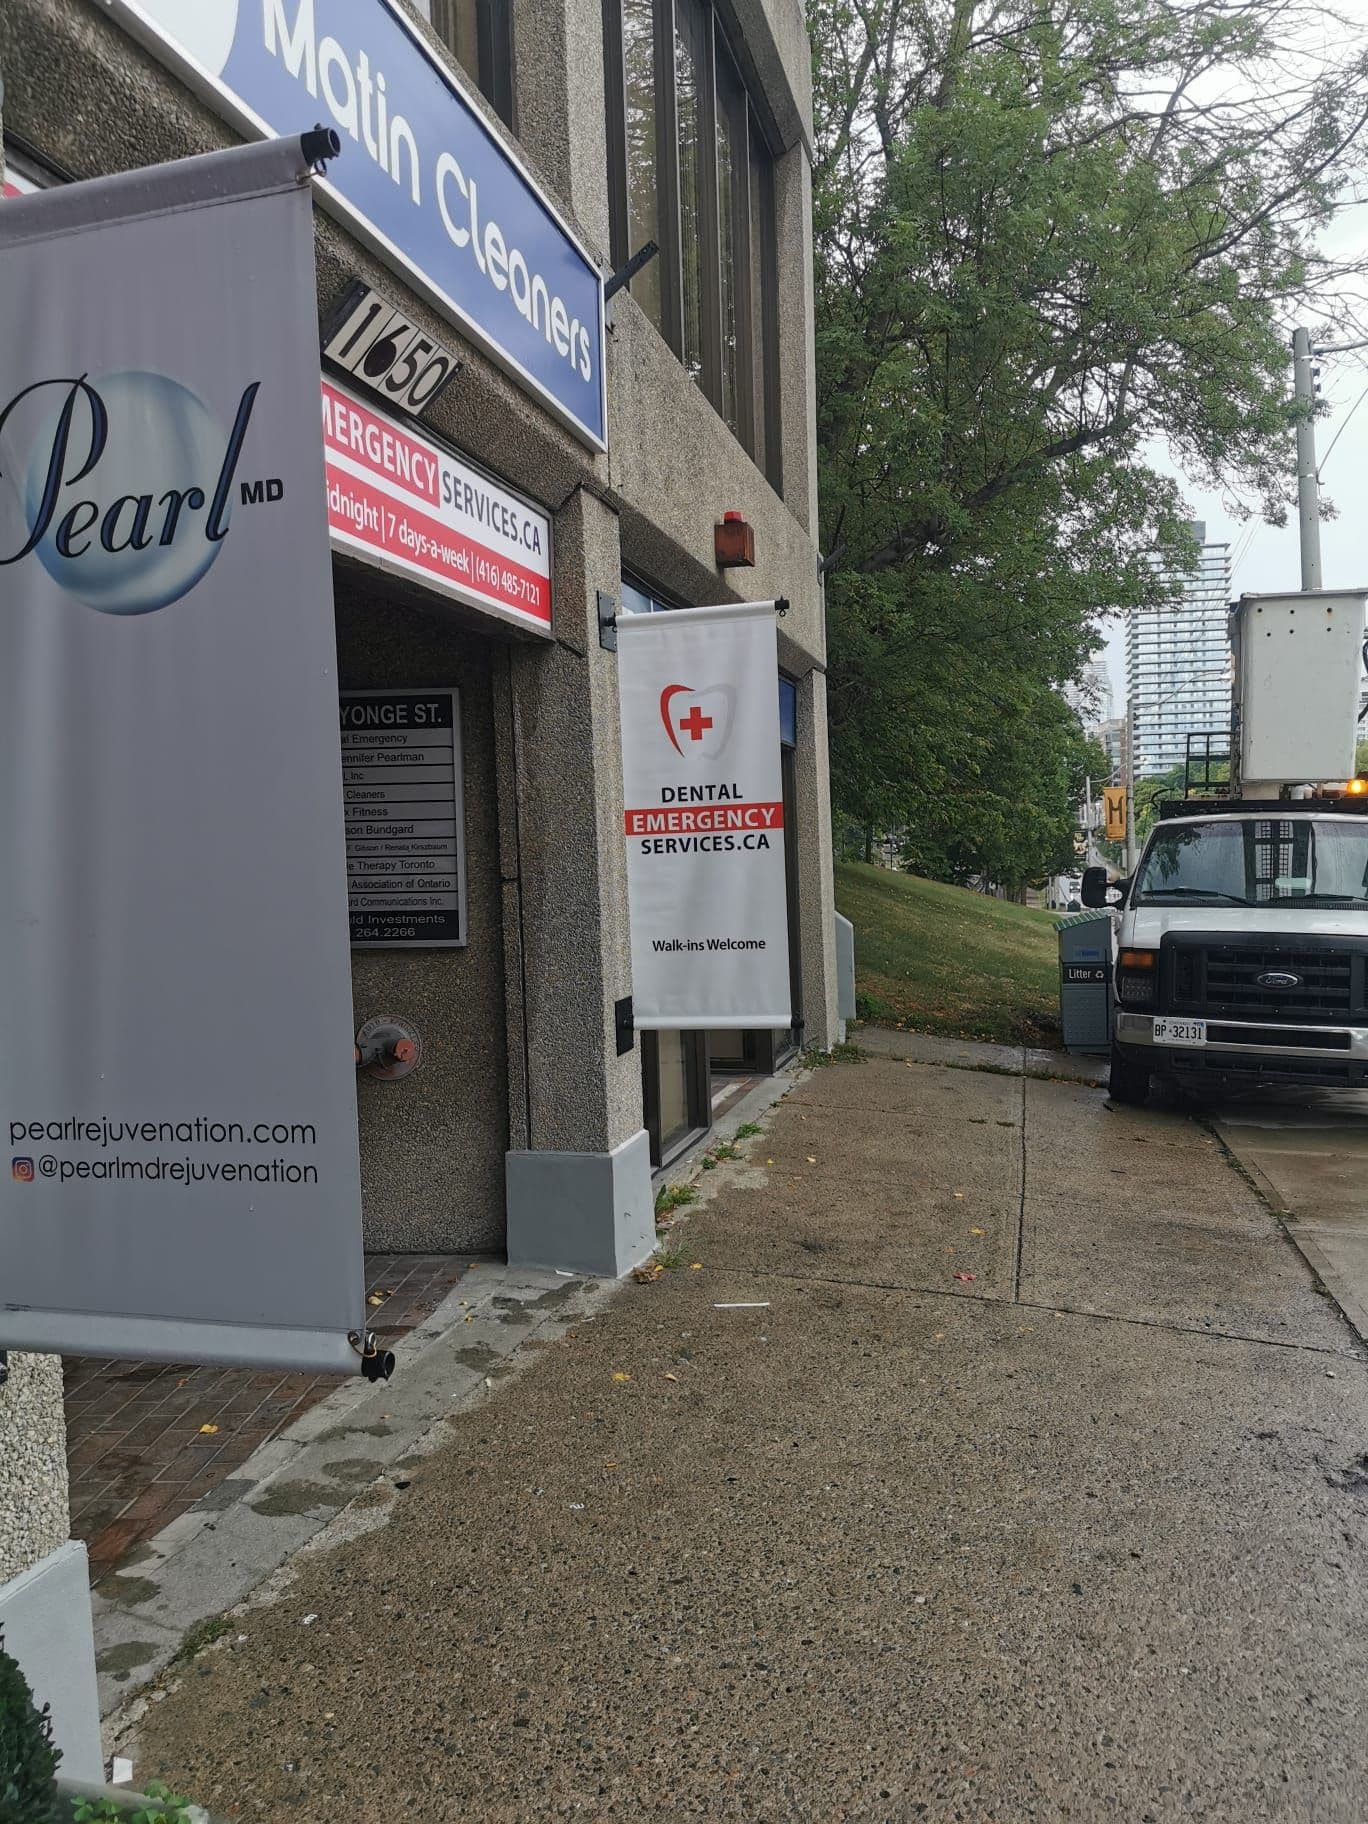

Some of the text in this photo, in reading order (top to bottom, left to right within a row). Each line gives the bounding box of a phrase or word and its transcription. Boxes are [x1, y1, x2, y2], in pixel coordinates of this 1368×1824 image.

[263, 0, 592, 383] Matin Cleaners
[338, 302, 450, 407] 1650
[0, 372, 284, 566] Pearl MD
[442, 470, 542, 556] SERVICES.CA
[387, 513, 396, 538] 7
[399, 518, 469, 573] days-a-week
[475, 555, 500, 591] (416)
[501, 571, 540, 607] 485-7121
[340, 703, 442, 725] YONGE ST.
[352, 734, 408, 745] Emergency
[377, 752, 425, 762] Pearlman
[346, 791, 386, 799] Cleaners
[661, 783, 743, 803] DENTAL
[352, 807, 389, 817] Fitness
[633, 808, 776, 832] EMERGENCY
[366, 824, 414, 836] Bundgard
[640, 833, 770, 855] SERVICES.CA
[358, 861, 396, 872] Therapy
[400, 860, 435, 870] Toronto
[351, 878, 451, 889] Association of Ontario
[360, 897, 427, 907] Communications
[368, 914, 446, 925] Investments
[652, 937, 766, 952] Walk-ins Welcome
[1068, 968, 1092, 979] Litter
[1154, 1024, 1202, 1040] BP 32131
[9, 1116, 316, 1148] pearlrejuvenation.com
[38, 1154, 319, 1186] @pearlmdrejuvenation
